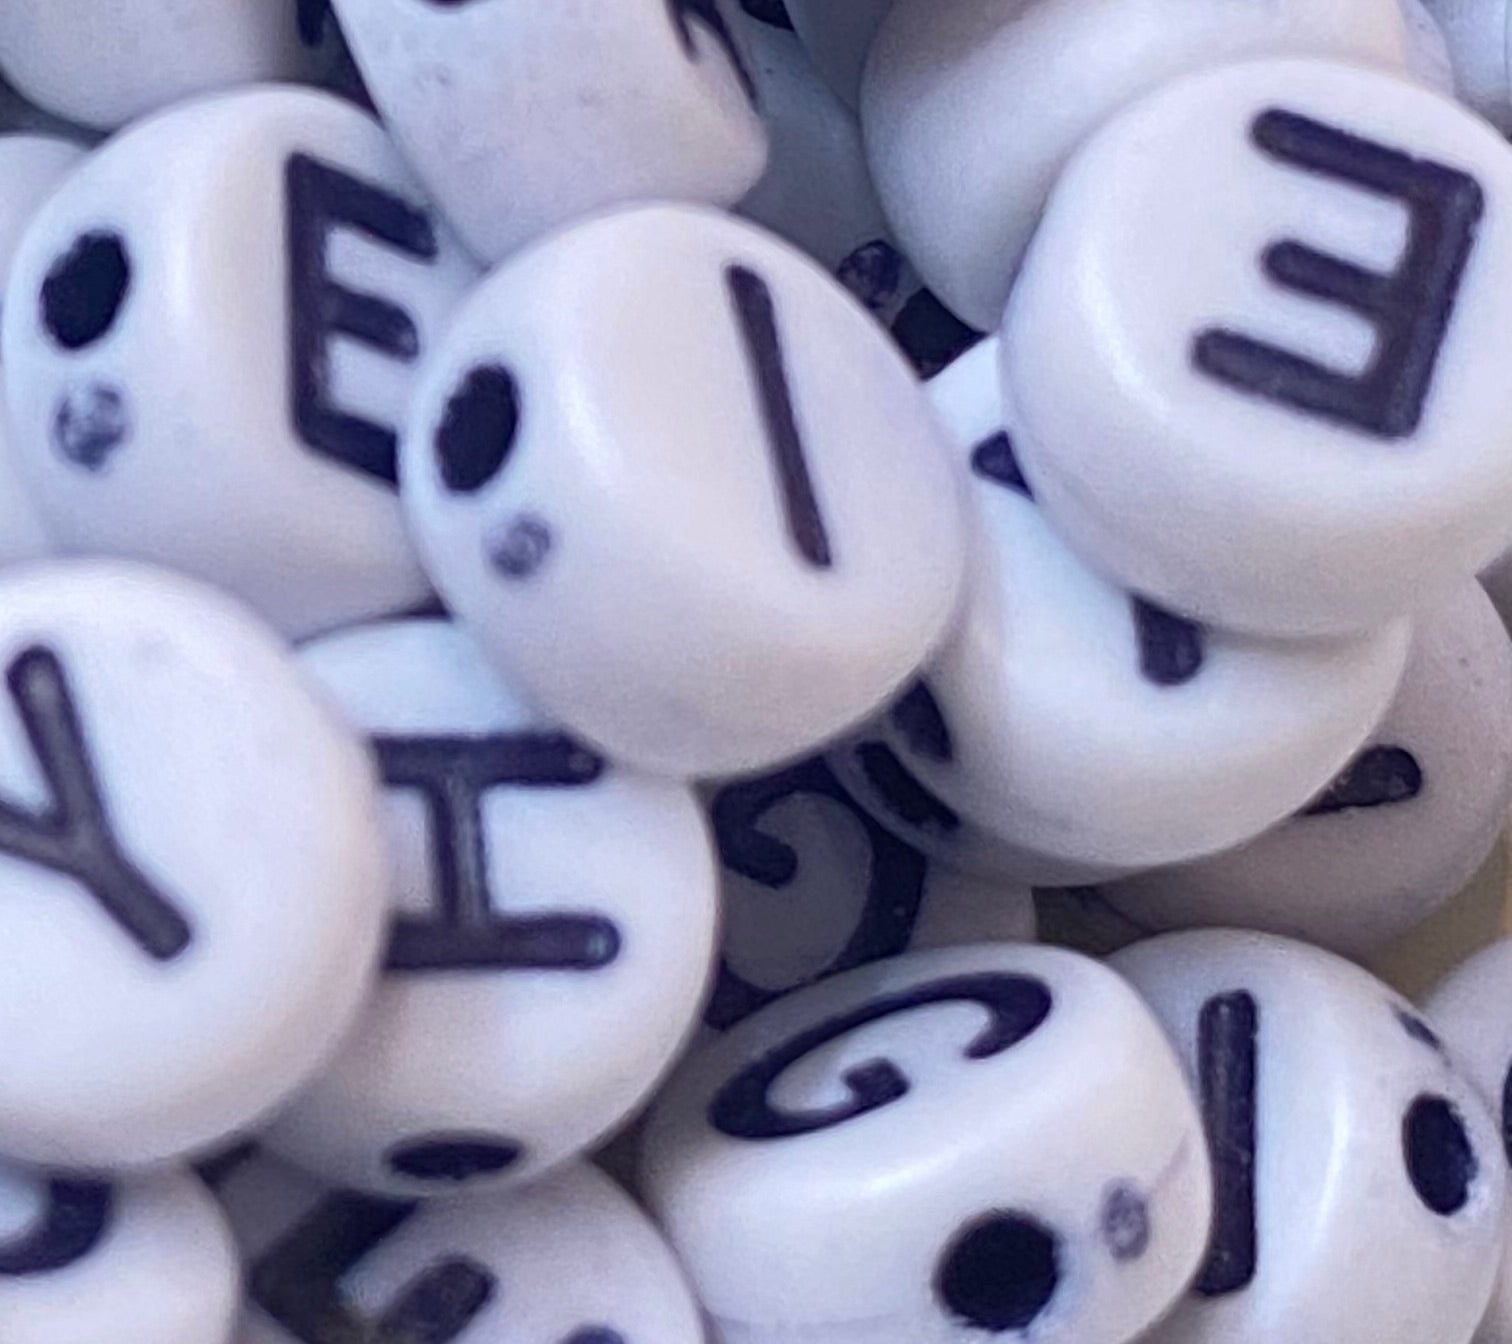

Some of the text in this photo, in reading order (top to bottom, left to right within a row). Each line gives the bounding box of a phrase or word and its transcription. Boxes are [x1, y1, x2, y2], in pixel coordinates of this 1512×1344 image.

[284, 151, 438, 494] E
[725, 263, 832, 571] I
[1190, 106, 1484, 441] E
[368, 731, 622, 973] H
[710, 971, 1054, 1141] G
[1194, 988, 1258, 1298] I
